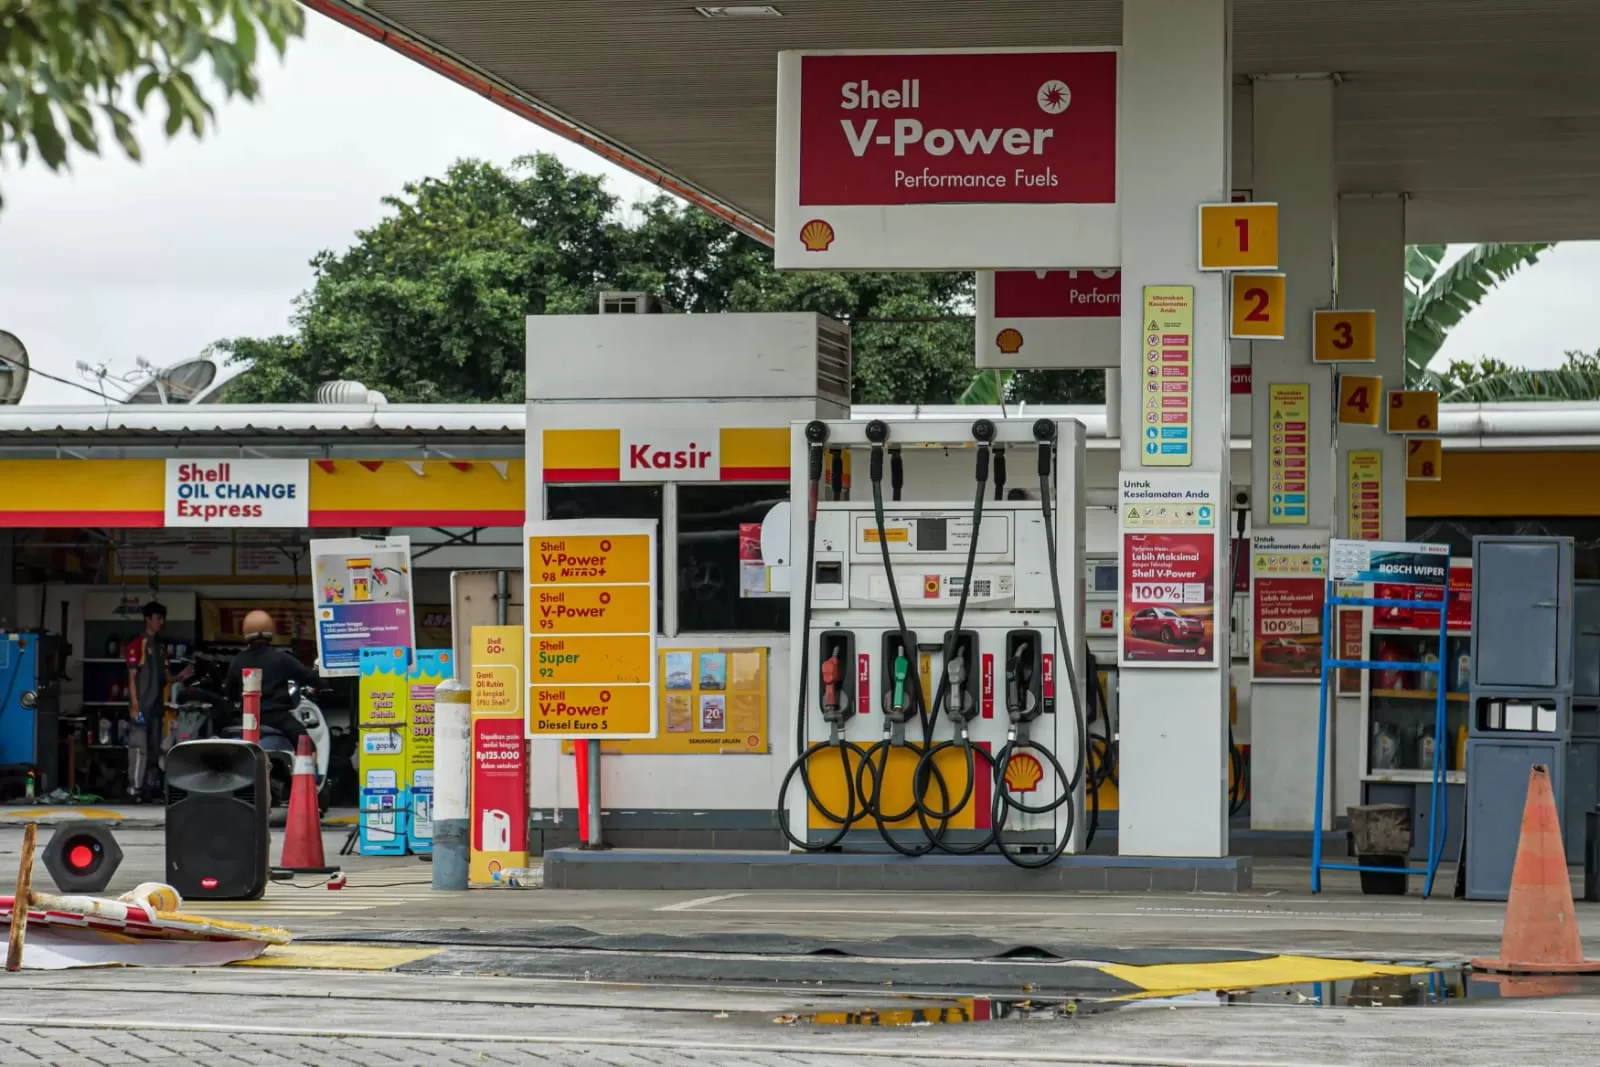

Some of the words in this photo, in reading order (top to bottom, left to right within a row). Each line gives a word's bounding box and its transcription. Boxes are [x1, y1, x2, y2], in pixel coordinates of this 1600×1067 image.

[840, 79, 920, 109] Shell
[840, 118, 1054, 157] V-Power
[894, 168, 1006, 188] Performance
[1015, 167, 1058, 187] Fuels
[1234, 218, 1249, 252] 1
[1243, 288, 1270, 322] 2
[1332, 321, 1354, 349] 3
[1346, 386, 1369, 413] 4
[1417, 414, 1430, 429] 6
[1409, 440, 1422, 455] 7
[629, 442, 712, 469] Kasir
[178, 463, 230, 482] Shell
[1422, 461, 1434, 476] 8
[1123, 480, 1151, 488] Untuk
[177, 484, 209, 499] OIL
[215, 483, 297, 500] CHANGE
[1123, 490, 1182, 499] Keselamatan
[1185, 490, 1210, 499] Anda
[176, 500, 263, 522] Express
[540, 541, 566, 552] Shell
[540, 553, 607, 567] V-Power
[1132, 552, 1155, 561] Lebih
[1156, 552, 1200, 561] Maksimal
[541, 572, 557, 582] 98
[1132, 568, 1155, 578] Shell
[1156, 569, 1197, 578] V-Power
[1379, 564, 1413, 575] BOSCH
[1413, 566, 1445, 577] WIPER
[539, 592, 565, 603] Shell
[1135, 586, 1181, 600] 100%
[540, 605, 606, 618] V-Power
[539, 619, 554, 629] 95
[1263, 620, 1300, 632] 100%
[487, 637, 502, 645] Shell
[539, 640, 565, 651] Shell
[487, 645, 505, 654] GO+
[538, 652, 580, 666] Super
[476, 671, 494, 679] Ganti
[539, 668, 554, 678] 92
[486, 680, 504, 688] Rutin
[538, 691, 566, 701] Shell
[539, 703, 609, 717] V-Power
[705, 708, 721, 719] 20
[538, 719, 571, 730] Diesel
[573, 720, 598, 730] Euro
[601, 720, 608, 730] 5
[476, 751, 520, 762] Rp125.000
